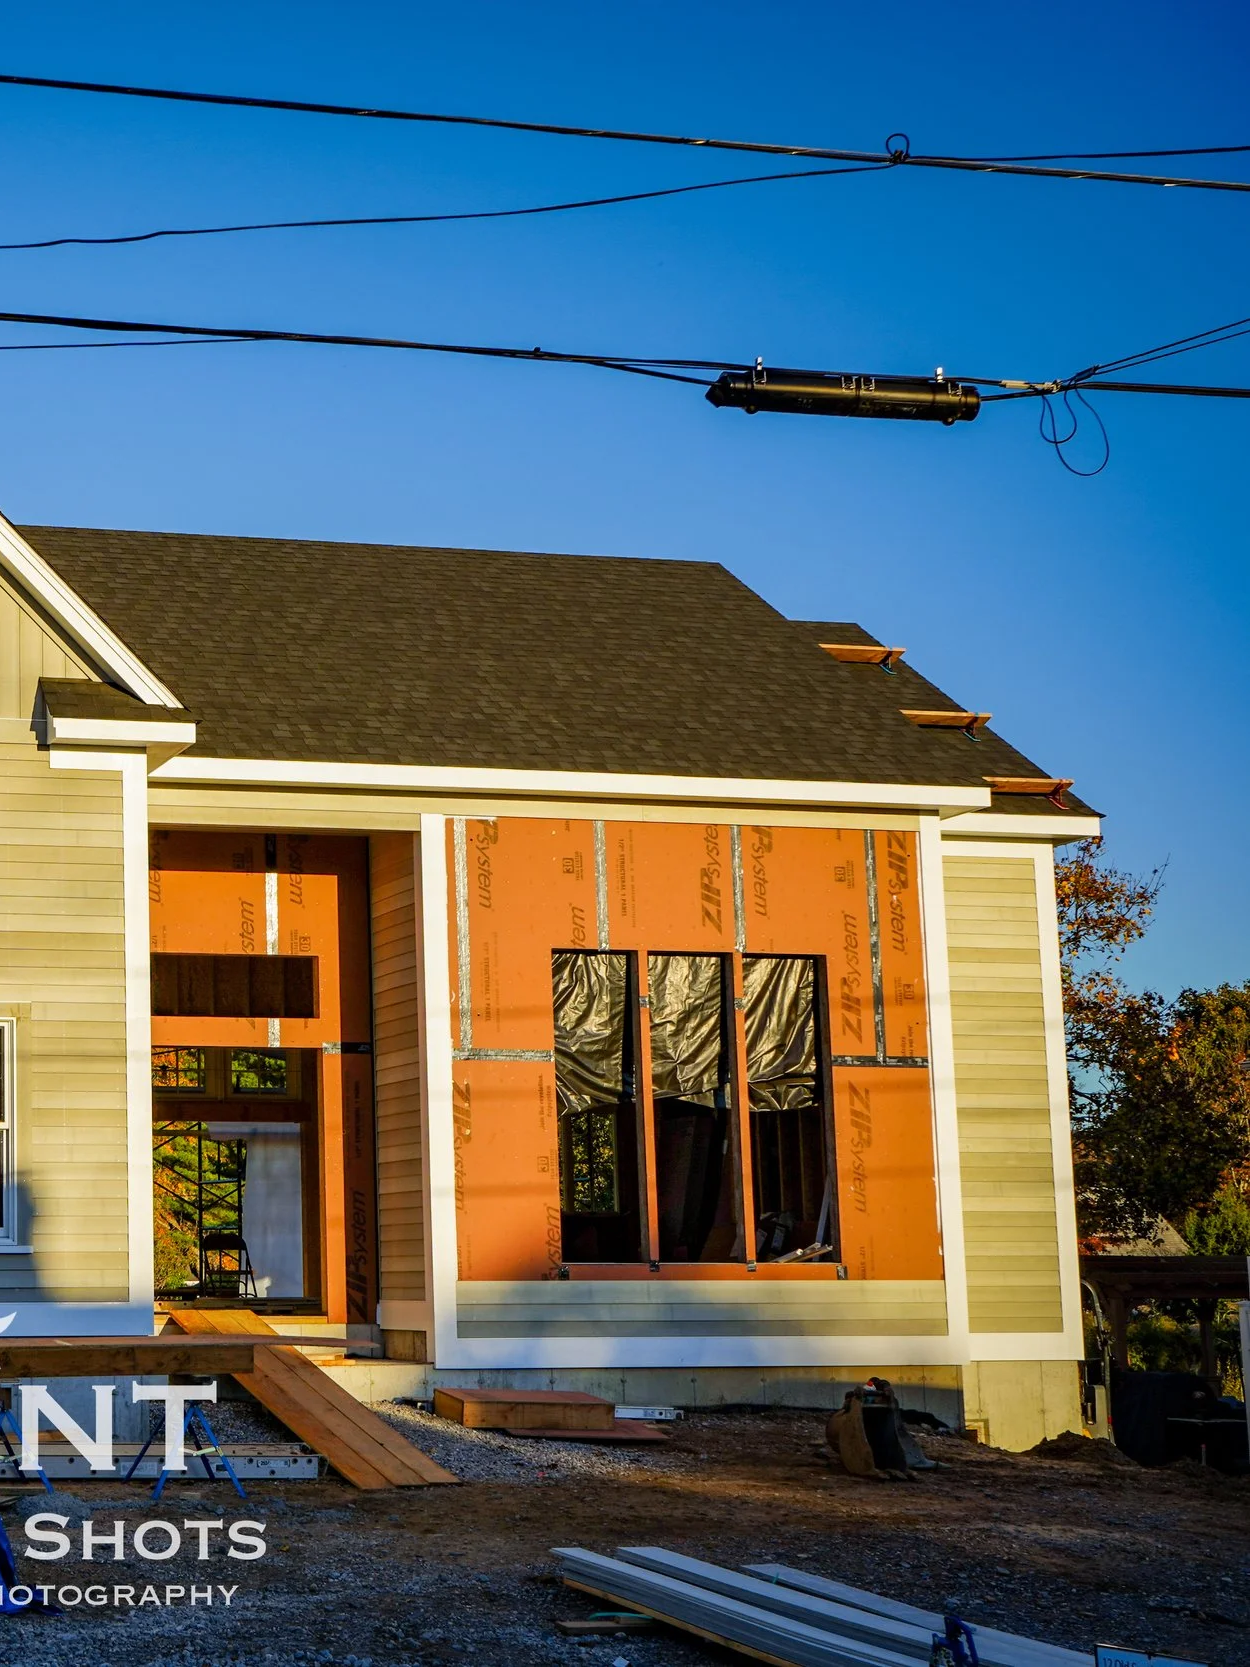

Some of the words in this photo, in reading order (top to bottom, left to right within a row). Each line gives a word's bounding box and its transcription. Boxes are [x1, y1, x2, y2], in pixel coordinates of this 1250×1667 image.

[562, 857, 575, 874] 30
[700, 825, 723, 936] ZIPsyste
[841, 912, 863, 1044] ZIPsystem
[903, 983, 915, 1000] 30
[848, 1080, 872, 1214] ZIPsystem
